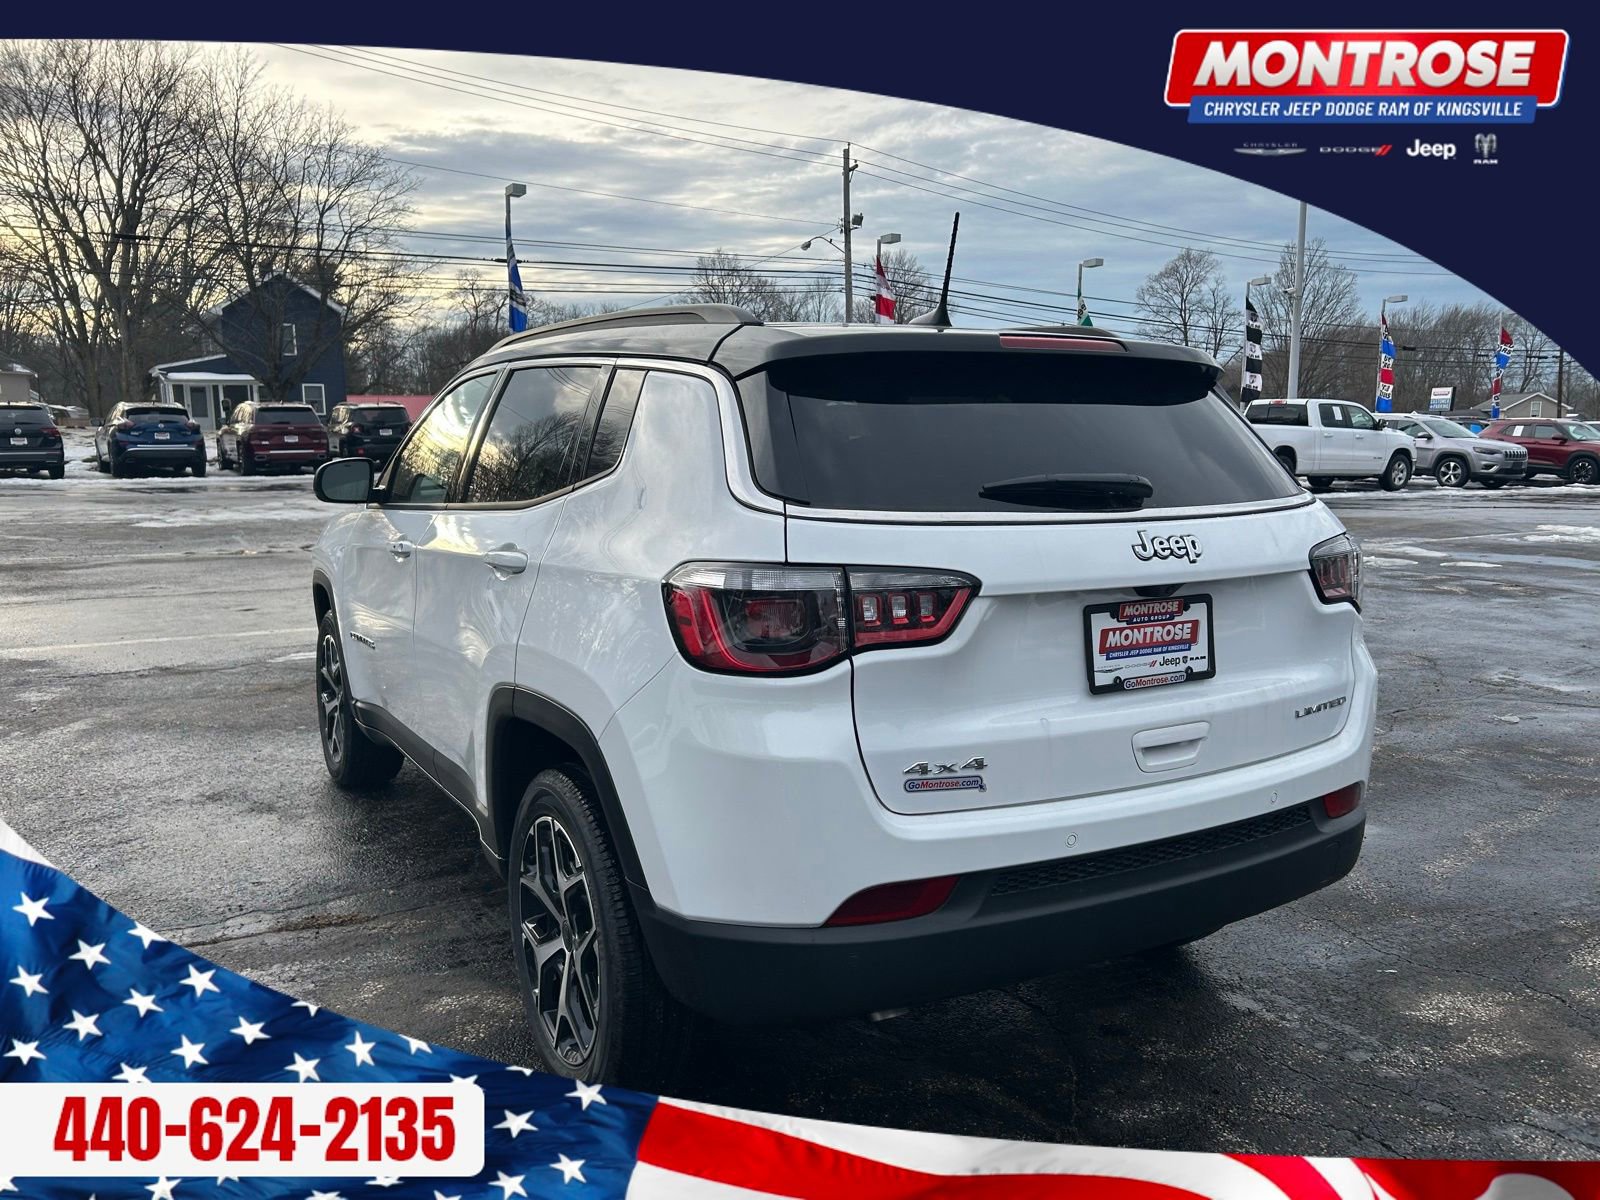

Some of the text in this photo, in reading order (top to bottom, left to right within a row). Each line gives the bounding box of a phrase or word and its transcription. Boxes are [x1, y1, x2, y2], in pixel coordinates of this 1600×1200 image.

[1131, 530, 1203, 564] Jeep
[1124, 601, 1179, 616] MONTROSE
[1106, 623, 1192, 647] MONTROSE
[1159, 656, 1181, 667] Jeep
[1125, 673, 1186, 689] GoMontrose.com
[1294, 696, 1347, 719] LIMITED
[903, 756, 989, 776] 4x4
[908, 779, 979, 790] GoMontrose.com
